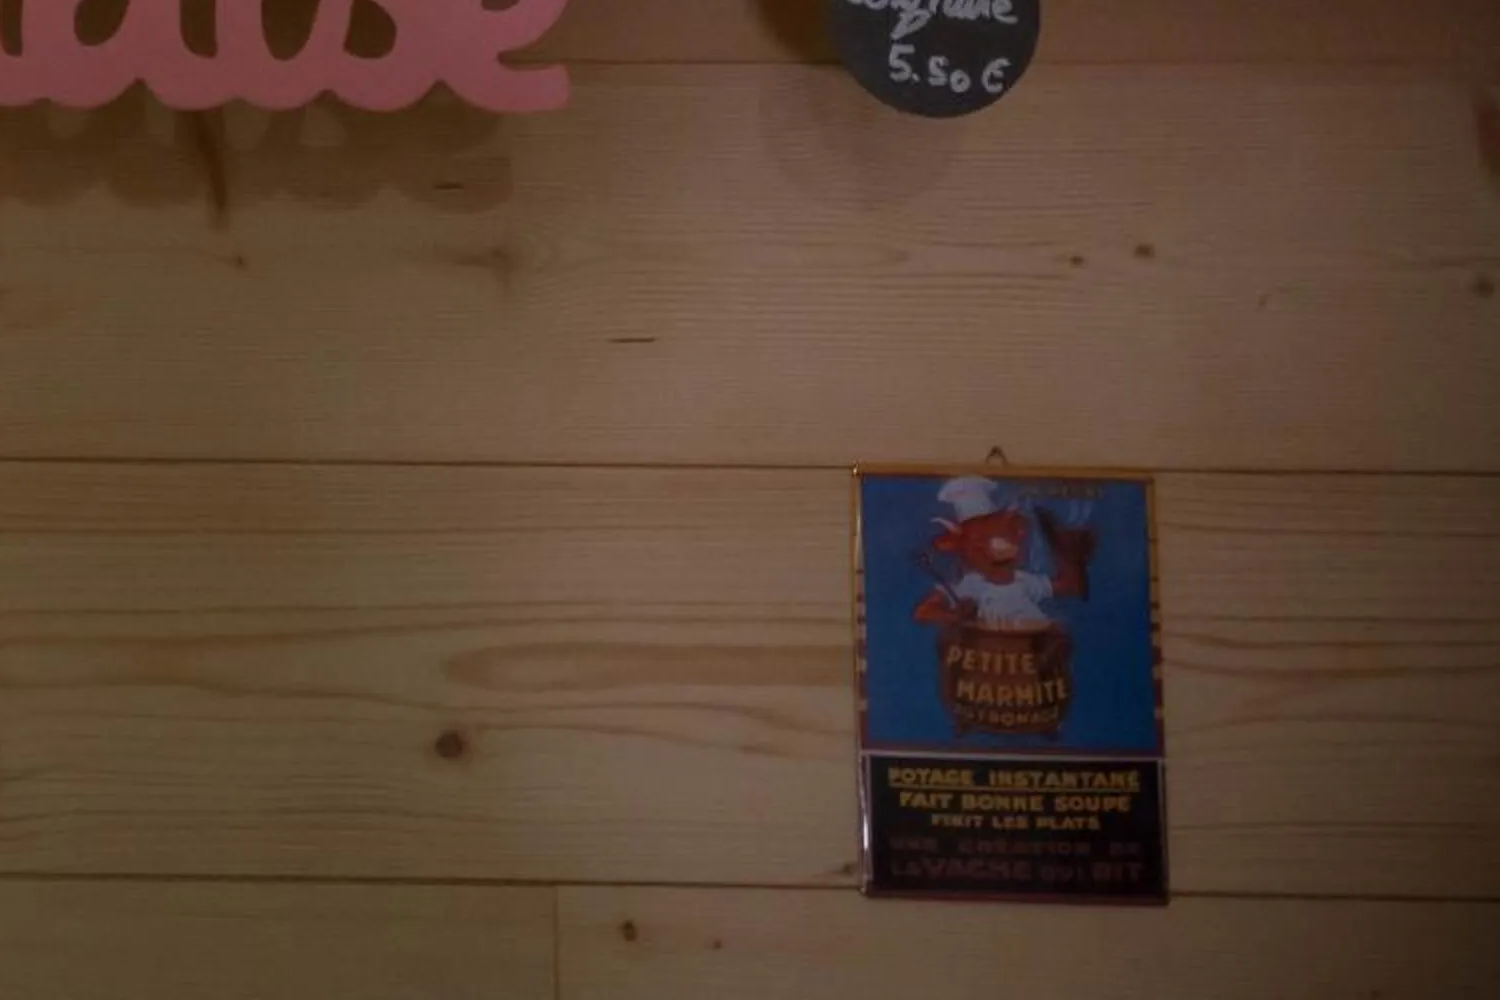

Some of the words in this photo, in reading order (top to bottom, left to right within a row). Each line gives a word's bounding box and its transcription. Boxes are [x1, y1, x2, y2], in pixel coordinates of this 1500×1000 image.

[889, 44, 971, 92] 5.50
[946, 645, 1036, 675] PETITE
[956, 677, 1070, 707] MARMITE
[889, 768, 974, 787] POTAGE
[899, 792, 953, 809] FAIT
[961, 793, 1044, 811] BONNE
[1054, 795, 1132, 812] SOUPE
[991, 815, 1030, 830] LES
[1036, 816, 1101, 830] PLATS
